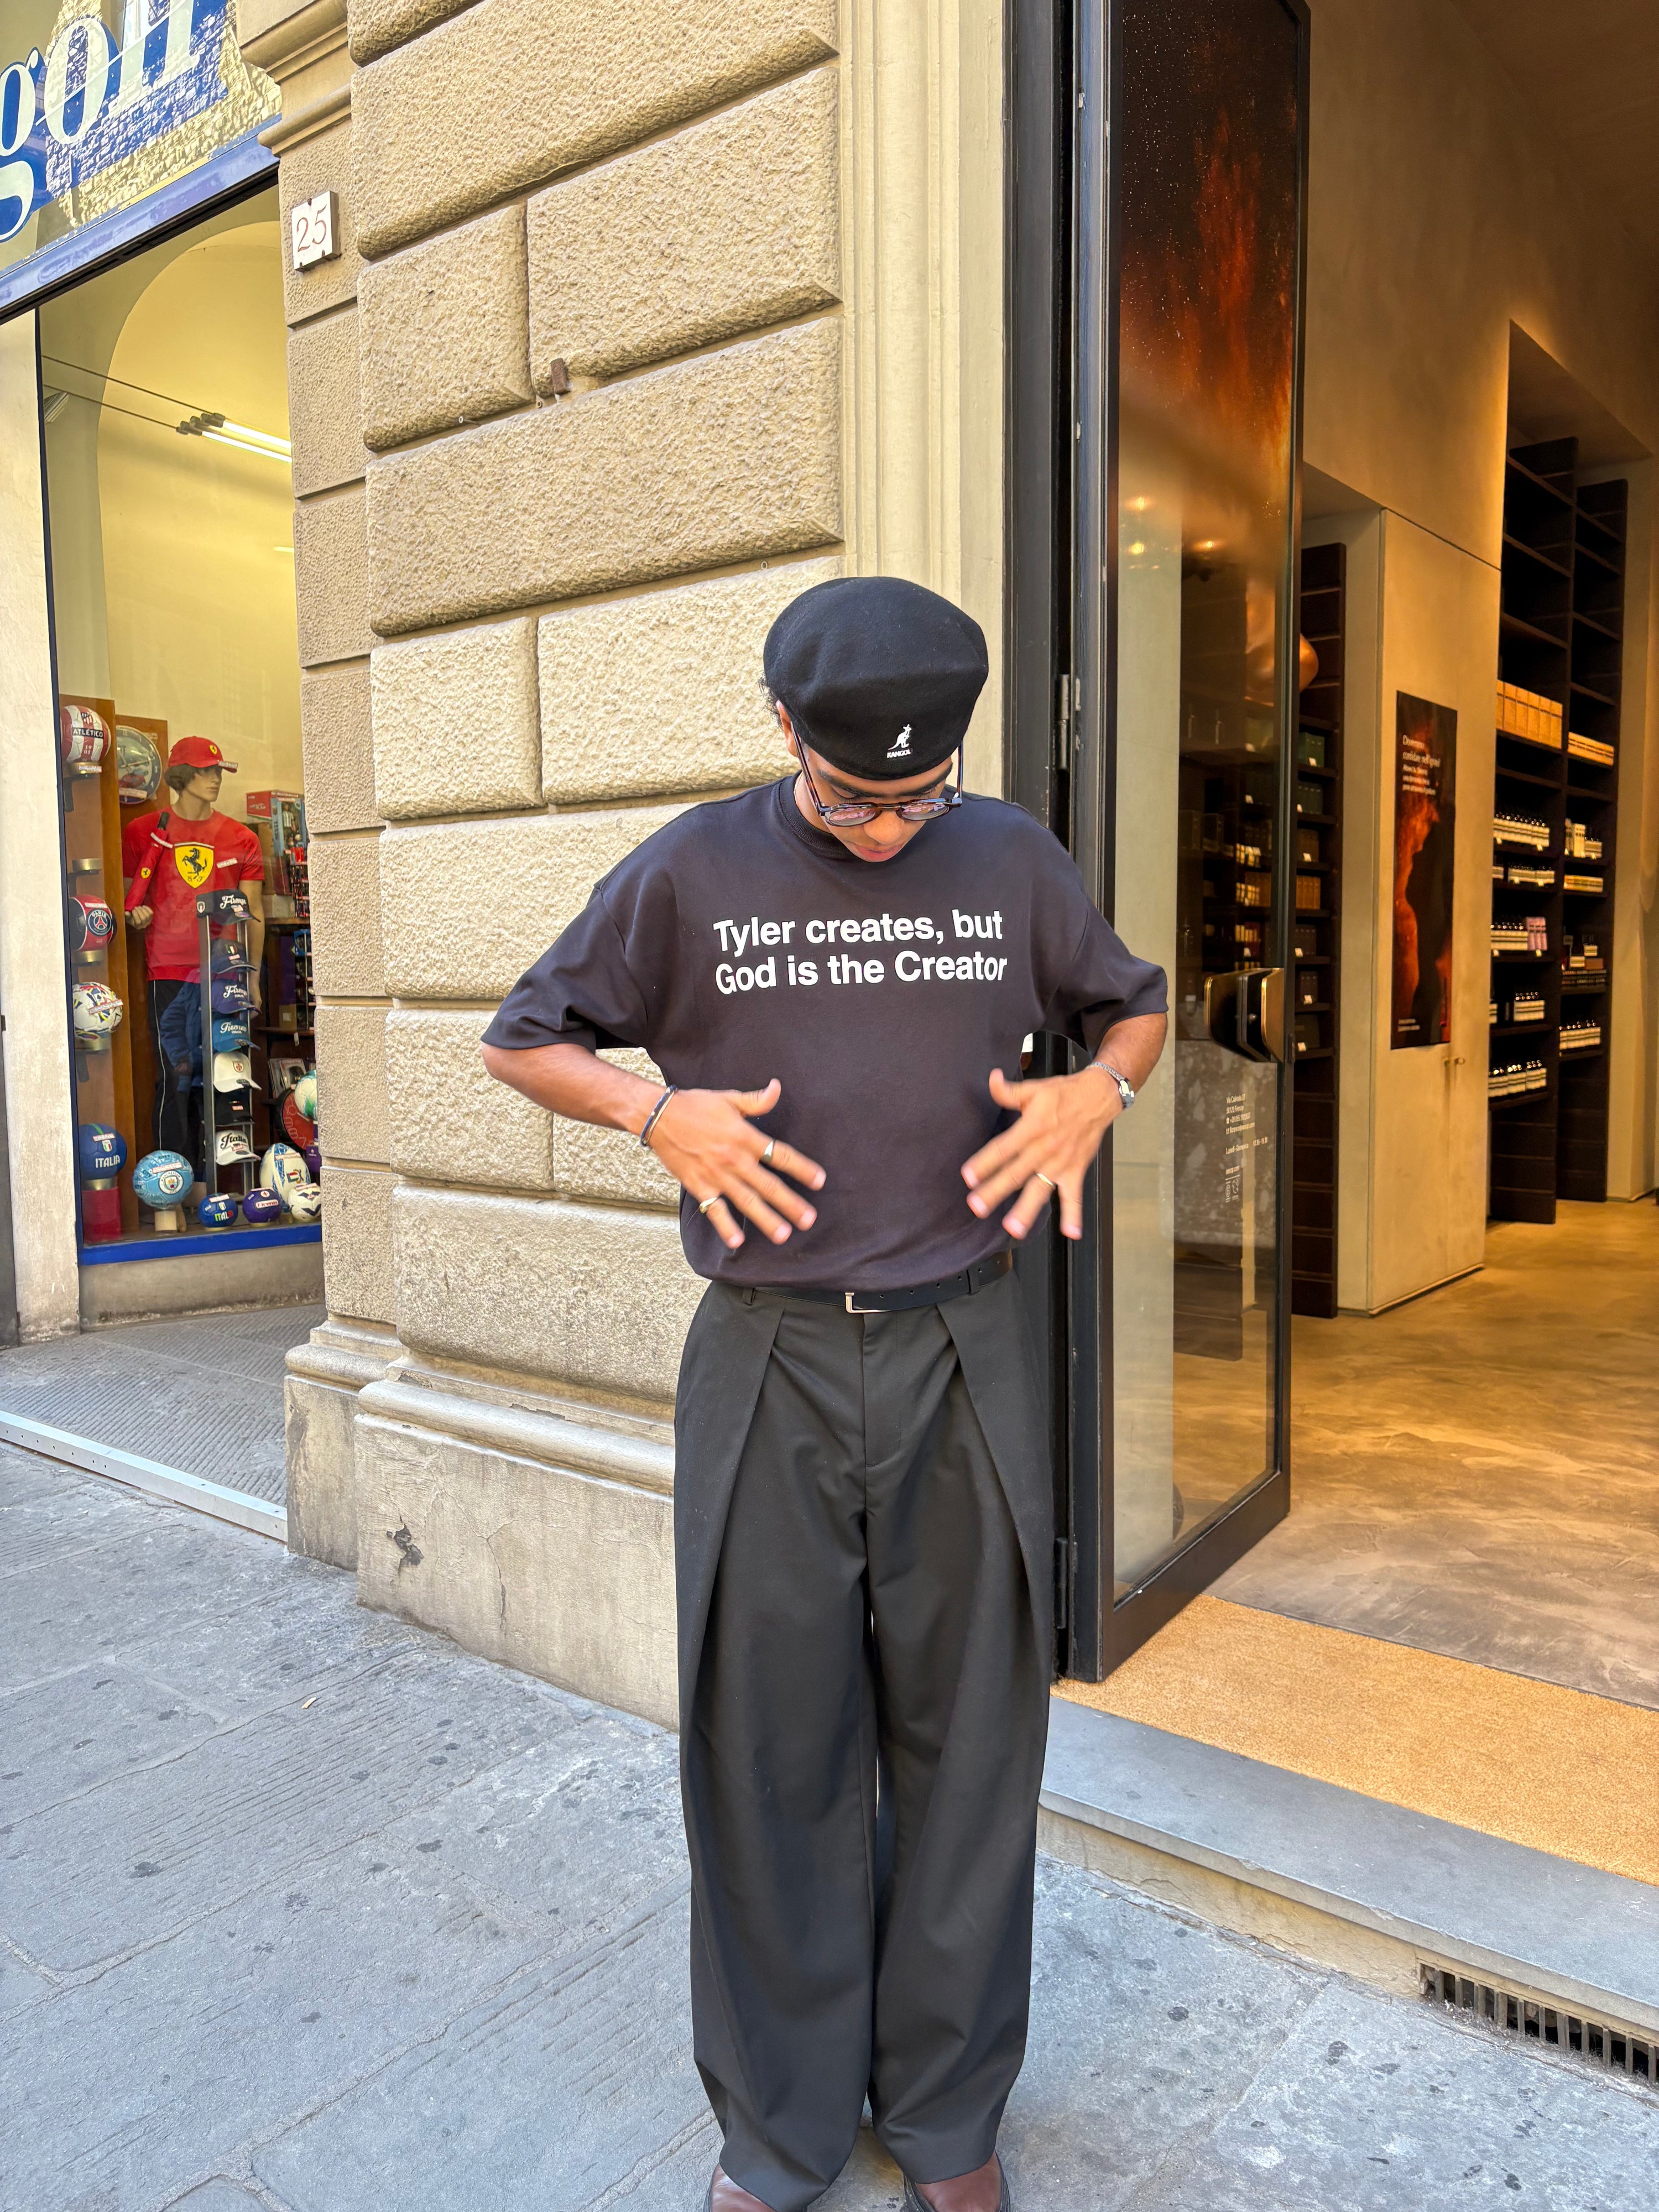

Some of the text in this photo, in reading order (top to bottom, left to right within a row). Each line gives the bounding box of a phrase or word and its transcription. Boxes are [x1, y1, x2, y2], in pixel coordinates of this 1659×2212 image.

[296, 206, 327, 253] 25
[886, 749, 911, 758] KANGOL
[713, 909, 1003, 957] Tyler creates, but
[715, 950, 1008, 995] God is the Creator
[220, 1133, 247, 1150] Italia
[95, 1154, 121, 1168] ITALIA
